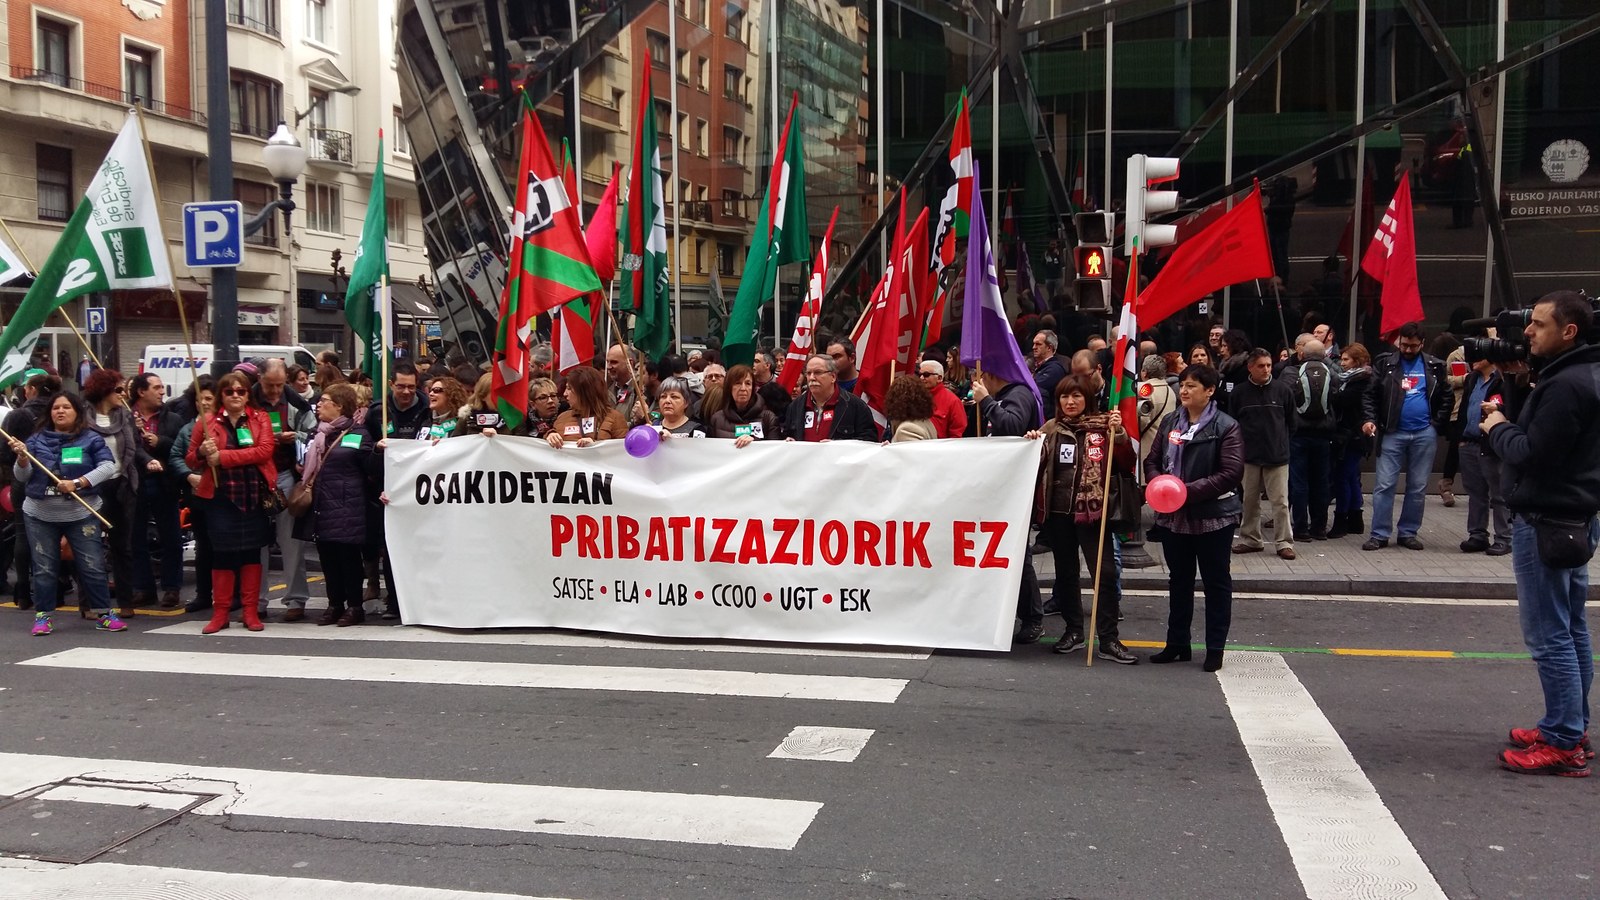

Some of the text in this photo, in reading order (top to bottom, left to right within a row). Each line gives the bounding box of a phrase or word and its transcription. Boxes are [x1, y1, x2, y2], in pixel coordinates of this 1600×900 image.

[1510, 192, 1544, 201] EUSKO
[1511, 206, 1571, 215] GOBIERNO
[194, 210, 229, 260] P
[90, 311, 102, 331] P
[149, 357, 208, 369] MRW
[415, 470, 614, 505] OSAKIDETZAN
[550, 514, 1010, 569] PRIBATIZAZIORIK EZ
[552, 576, 871, 613] SATSE ELA LAB CCOO UGT ESK
